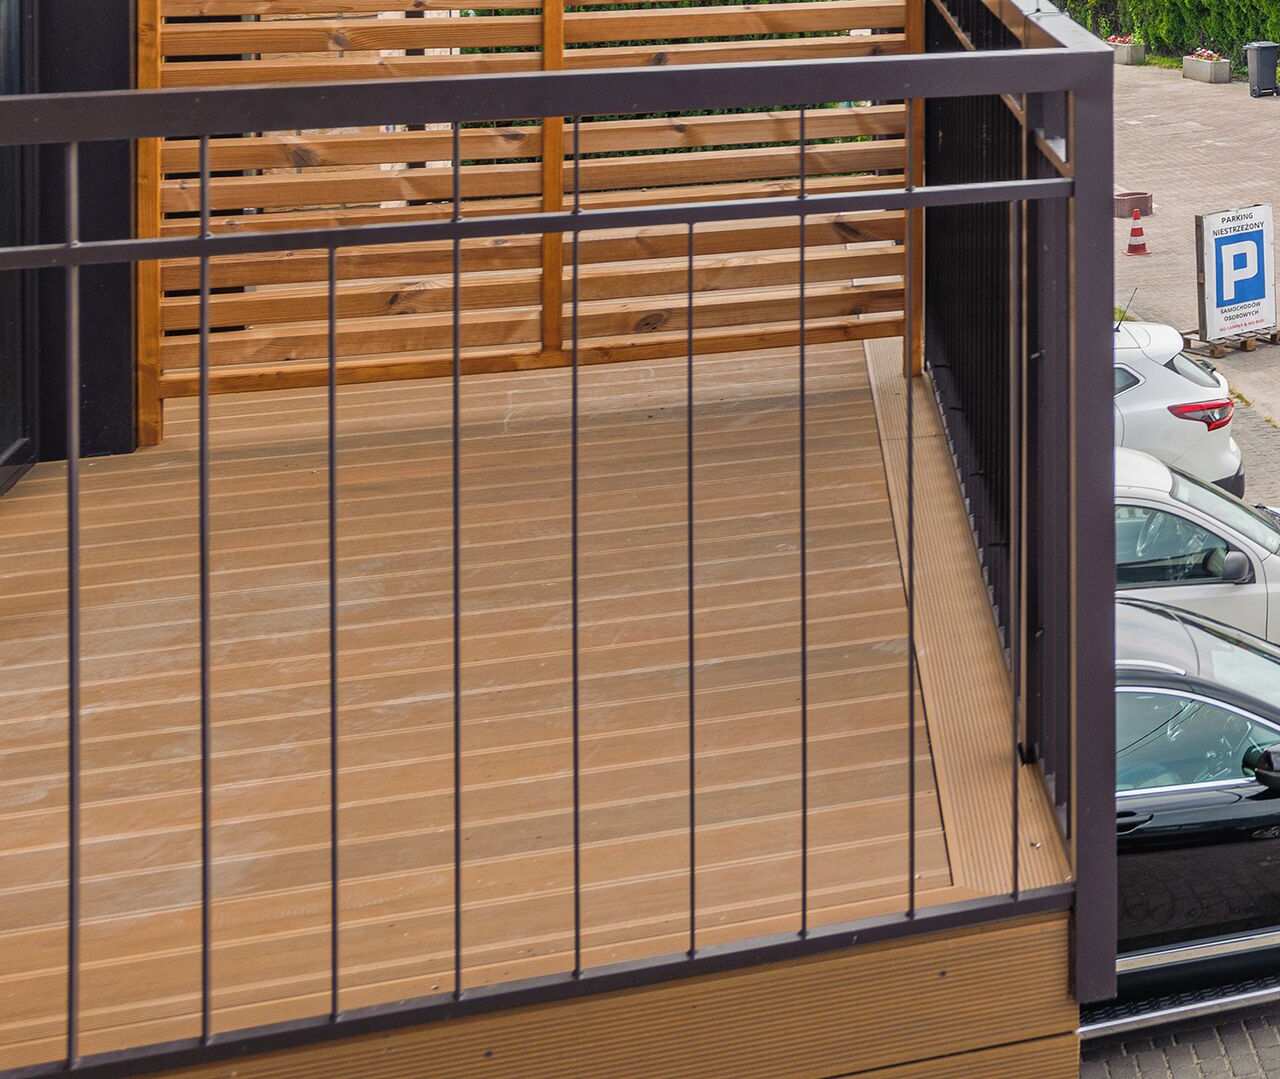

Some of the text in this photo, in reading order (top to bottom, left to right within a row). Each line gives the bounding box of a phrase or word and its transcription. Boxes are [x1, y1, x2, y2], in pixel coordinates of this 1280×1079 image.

[1222, 213, 1253, 223] PARKING
[1213, 222, 1264, 236] NIESTRZEŻONY
[1222, 241, 1258, 300] P
[1221, 302, 1261, 314] SAMOCHODÓW
[1224, 310, 1258, 321] OSOBOWYCH
